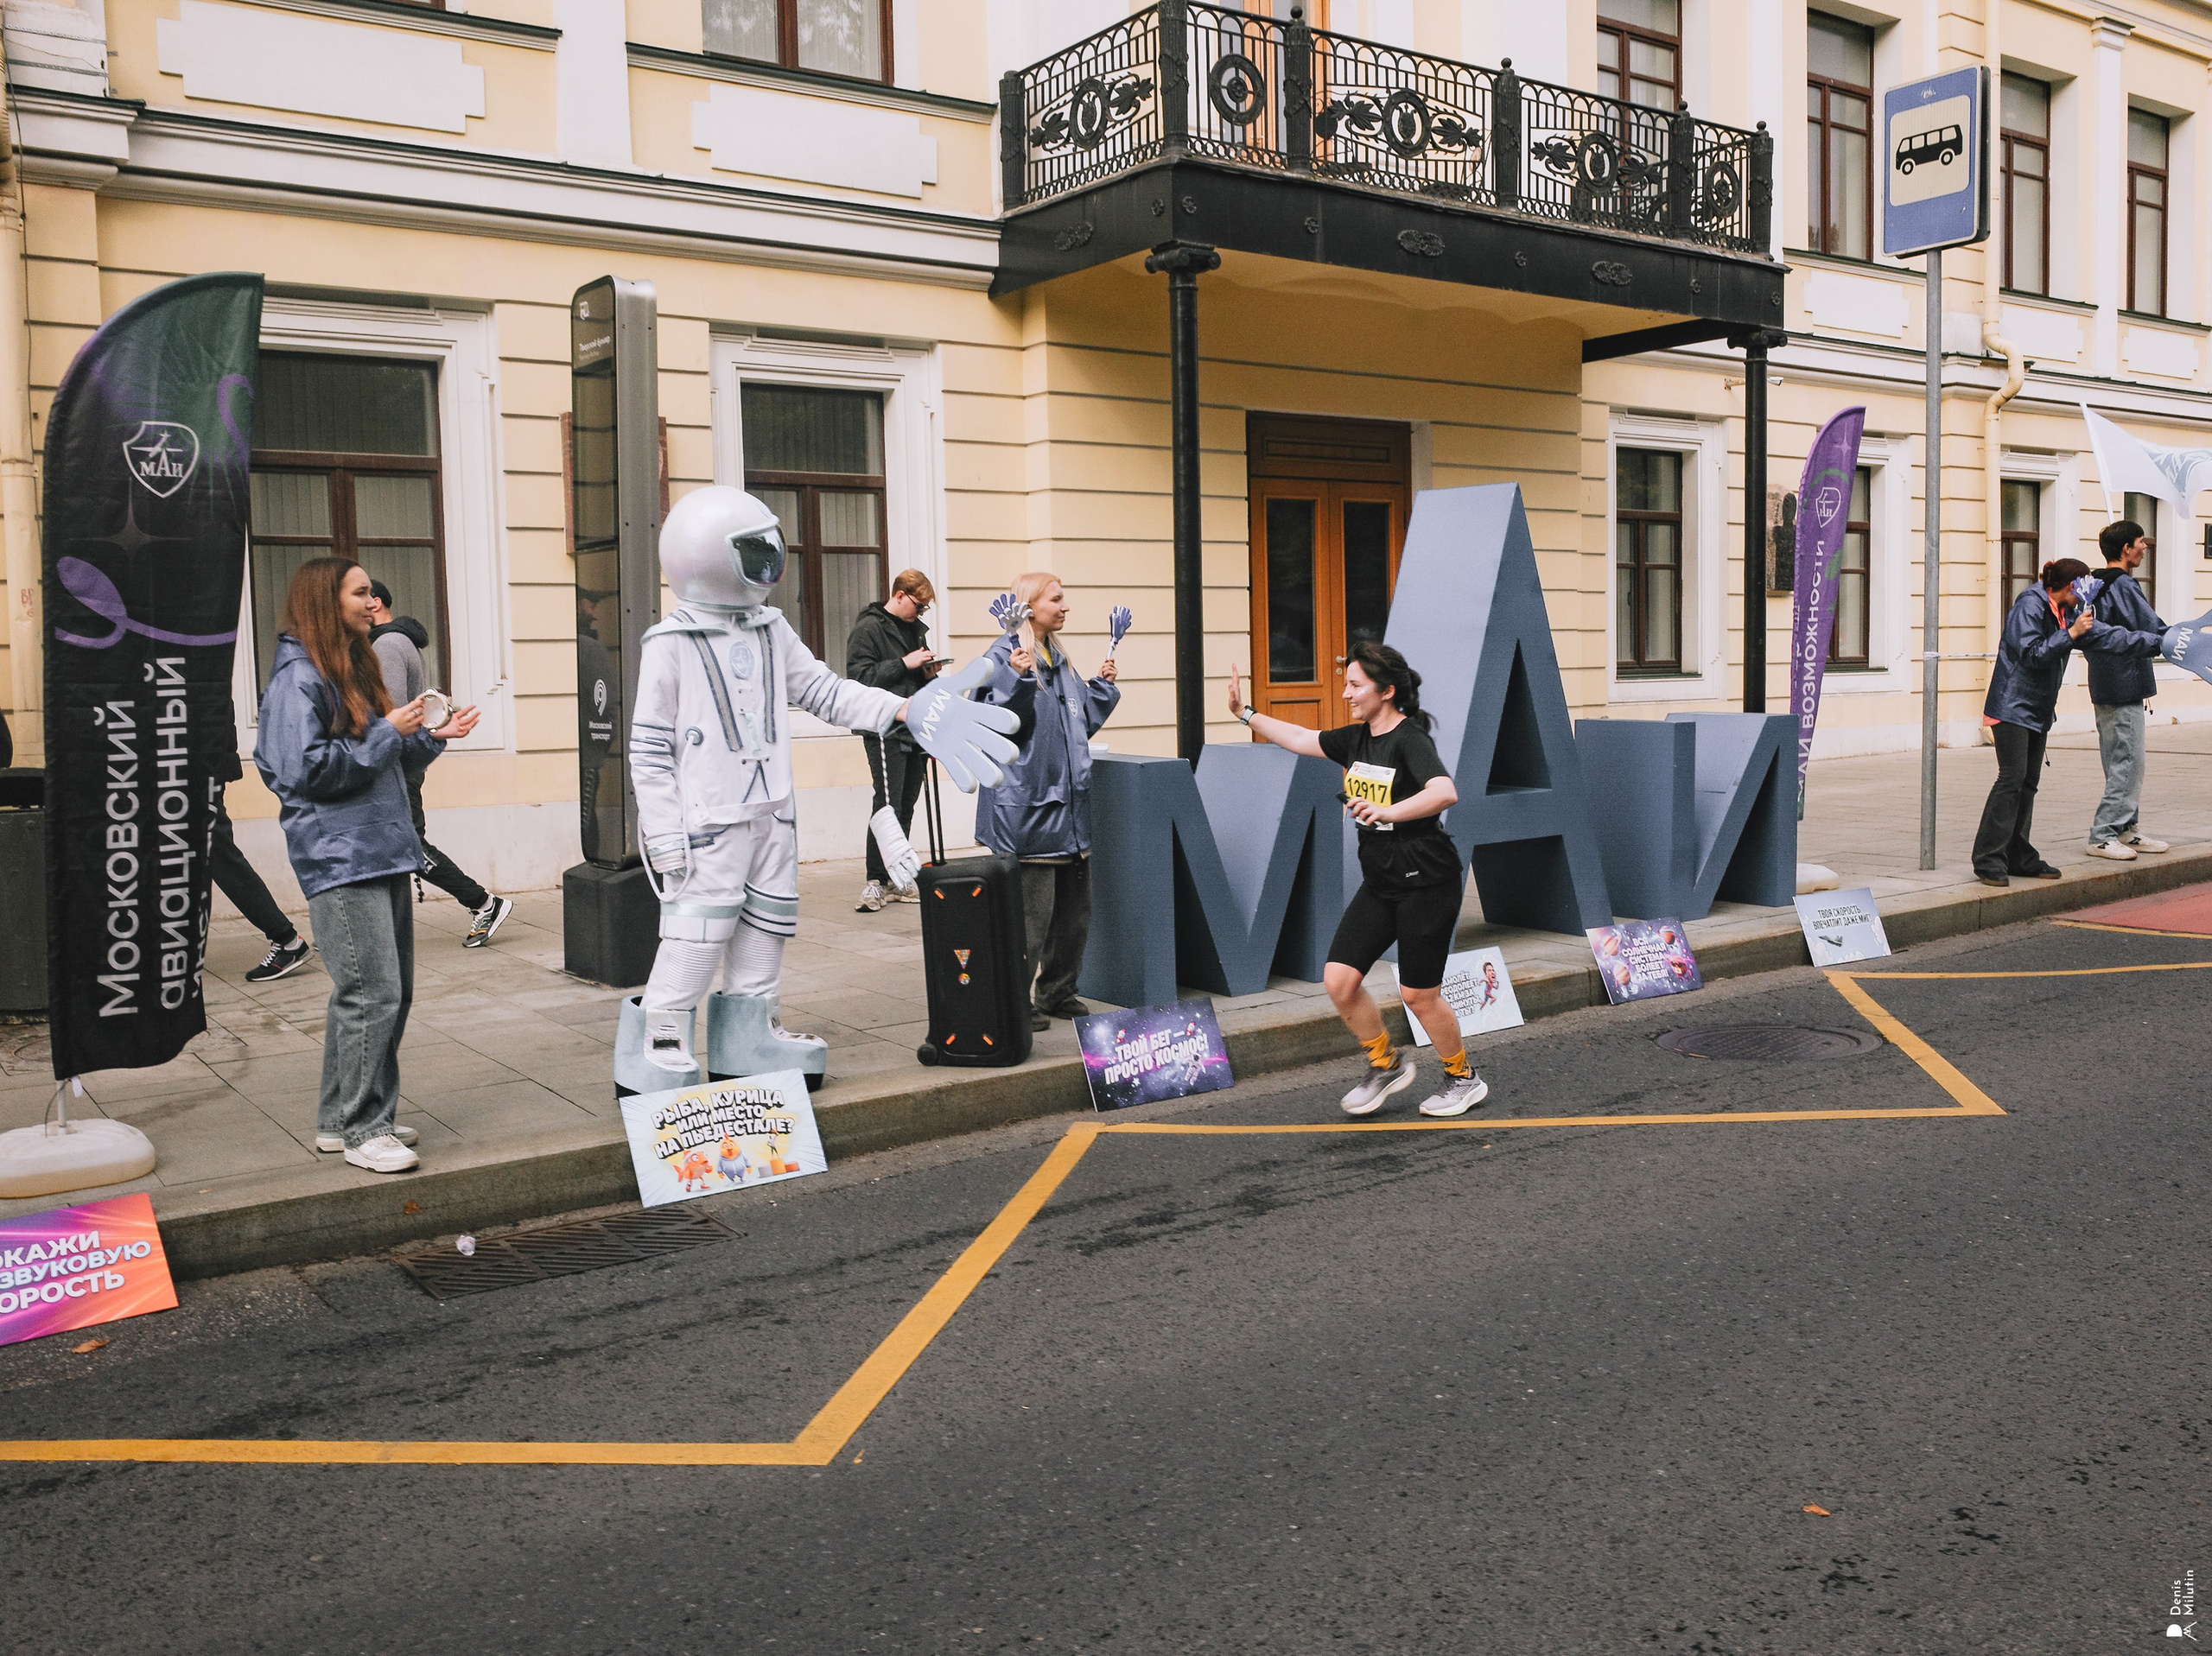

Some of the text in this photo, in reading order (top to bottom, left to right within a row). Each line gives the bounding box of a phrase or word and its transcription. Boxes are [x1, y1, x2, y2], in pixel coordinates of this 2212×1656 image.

[139, 447, 183, 478] МАИ
[1802, 540, 1825, 729] ВОЗМОЖНОСТИ
[2171, 627, 2194, 661] МАИ
[919, 688, 952, 742] МАИ
[1078, 481, 1799, 1008] МАИ
[1347, 777, 1388, 803] 12917
[143, 657, 197, 1010] авиационный
[93, 701, 141, 1018] Московский
[1832, 904, 1861, 917] СКОРОСТЬ
[1622, 942, 1668, 958] СОЛНЕЧНАЯ
[1630, 951, 1666, 966] СИСТЕМА
[1632, 936, 1649, 947] ВСЯ
[1441, 970, 1470, 988] АМОЛЁТ
[1635, 961, 1664, 973] БОЛЕЕТ
[1104, 1033, 1210, 1085] ПРОСТО КОСМОС!
[1115, 1034, 1149, 1063] ТВОЙ
[1150, 1029, 1173, 1050] БЕГ
[651, 1088, 785, 1130] РЫБА, КУРИЦА
[676, 1105, 766, 1135] ИЛИ МЕСТО
[654, 1117, 796, 1160] НА ПЬЕДЕСТАЛЕ?
[0, 1230, 101, 1269] КАЖИ
